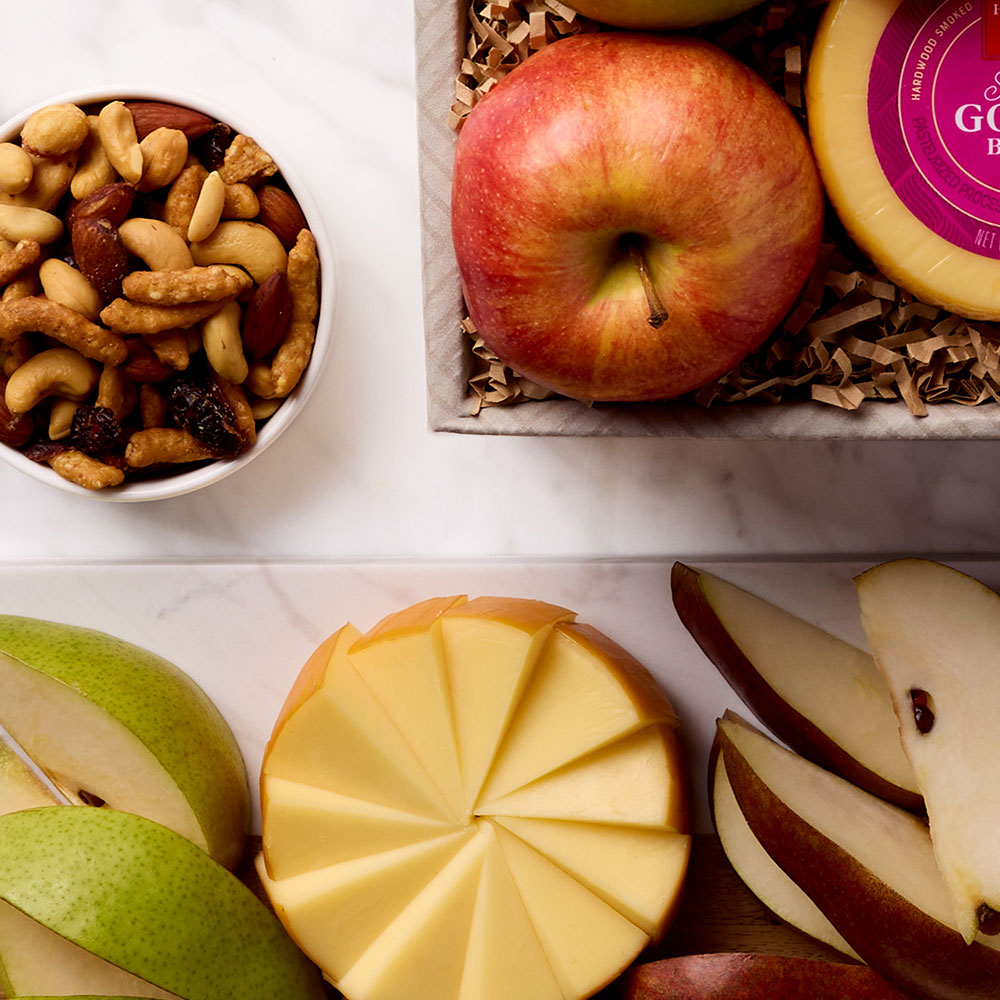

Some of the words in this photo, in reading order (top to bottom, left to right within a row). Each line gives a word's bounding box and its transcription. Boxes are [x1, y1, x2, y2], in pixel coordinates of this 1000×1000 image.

[911, 38, 938, 101] HARDWOOD
[935, 2, 973, 37] SMOKED
[912, 116, 960, 189] PASTEURIZED
[974, 229, 996, 249] NET
